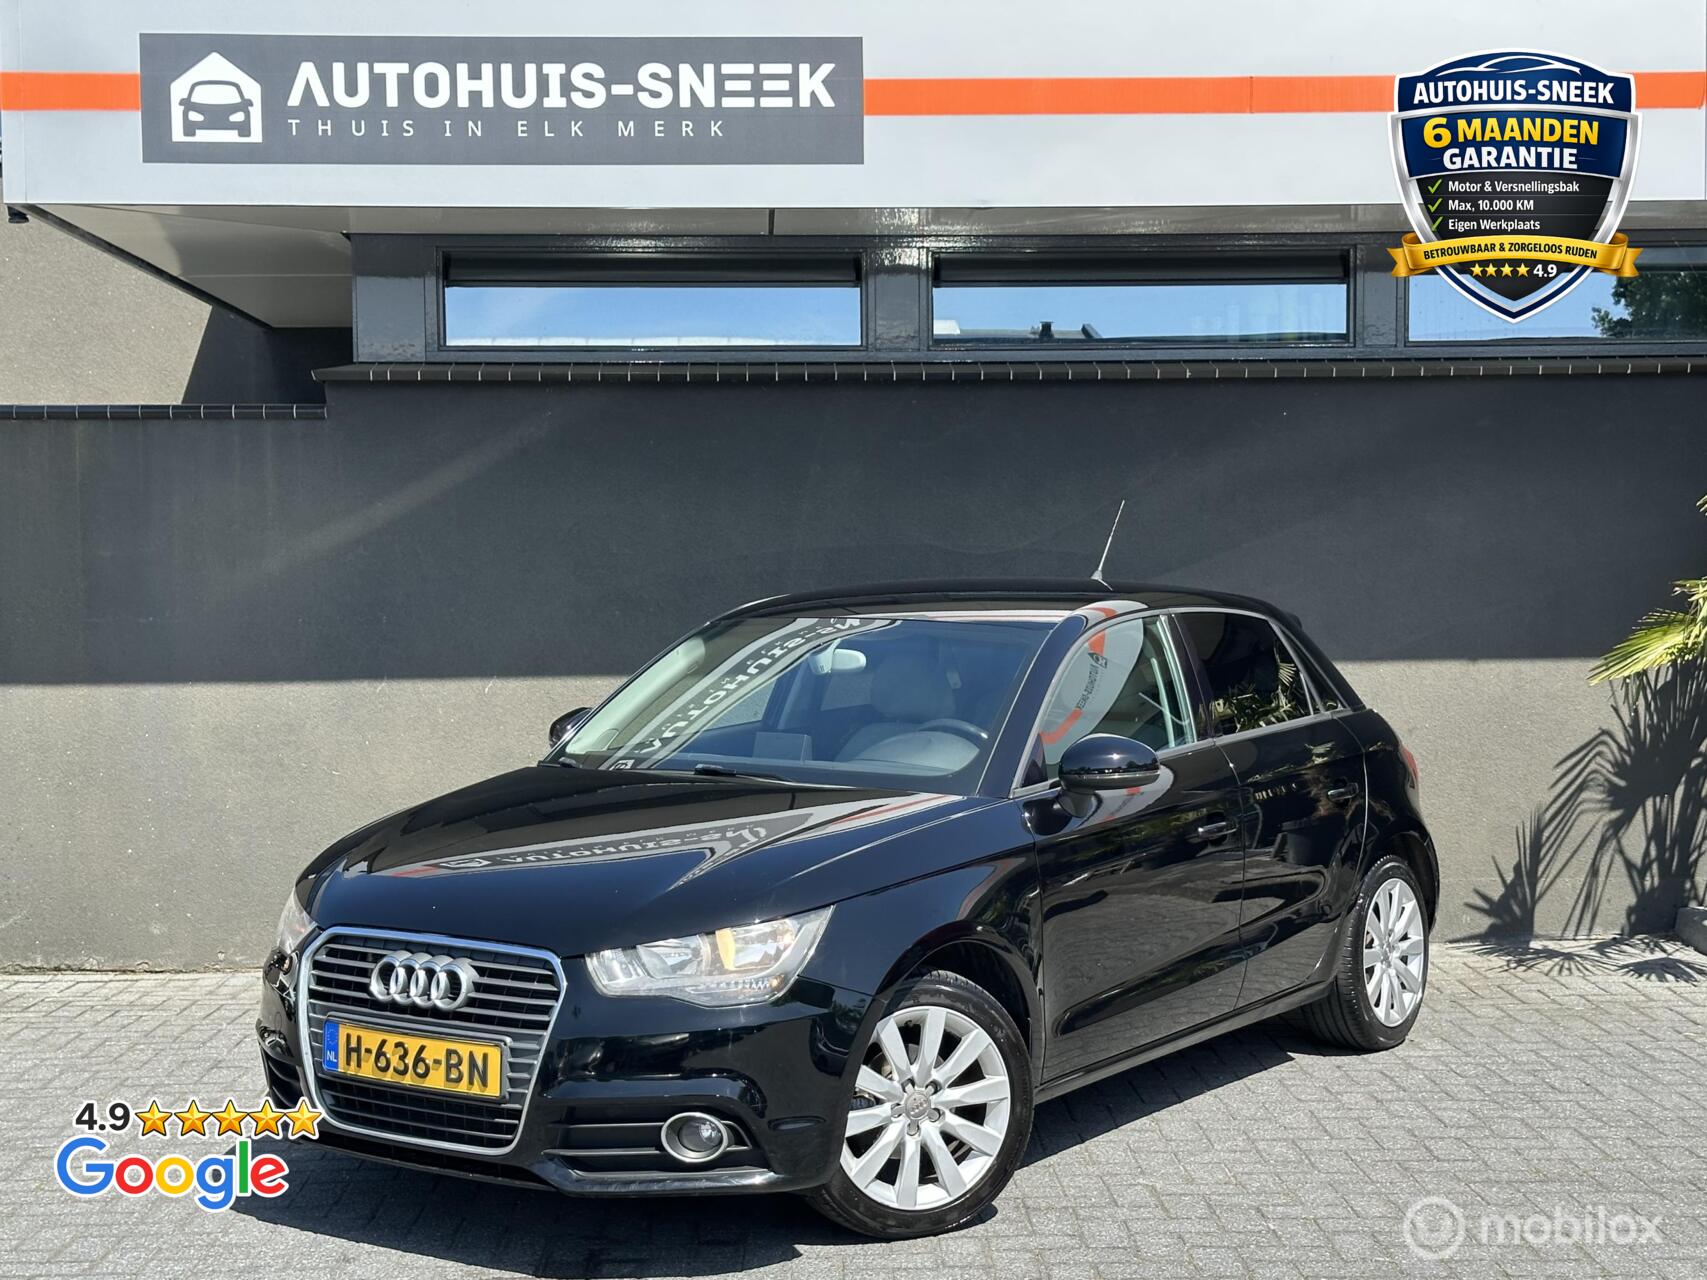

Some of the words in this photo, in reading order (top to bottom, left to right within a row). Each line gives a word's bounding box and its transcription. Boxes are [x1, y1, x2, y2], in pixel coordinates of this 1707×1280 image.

[287, 62, 836, 109] AUTOHUIS-SNEEK
[287, 119, 414, 137] THUIS
[444, 120, 482, 137] IN
[517, 120, 584, 137] ELK
[618, 120, 724, 137] MERK
[326, 1050, 337, 1063] NL
[345, 1032, 489, 1088] H-636-BN
